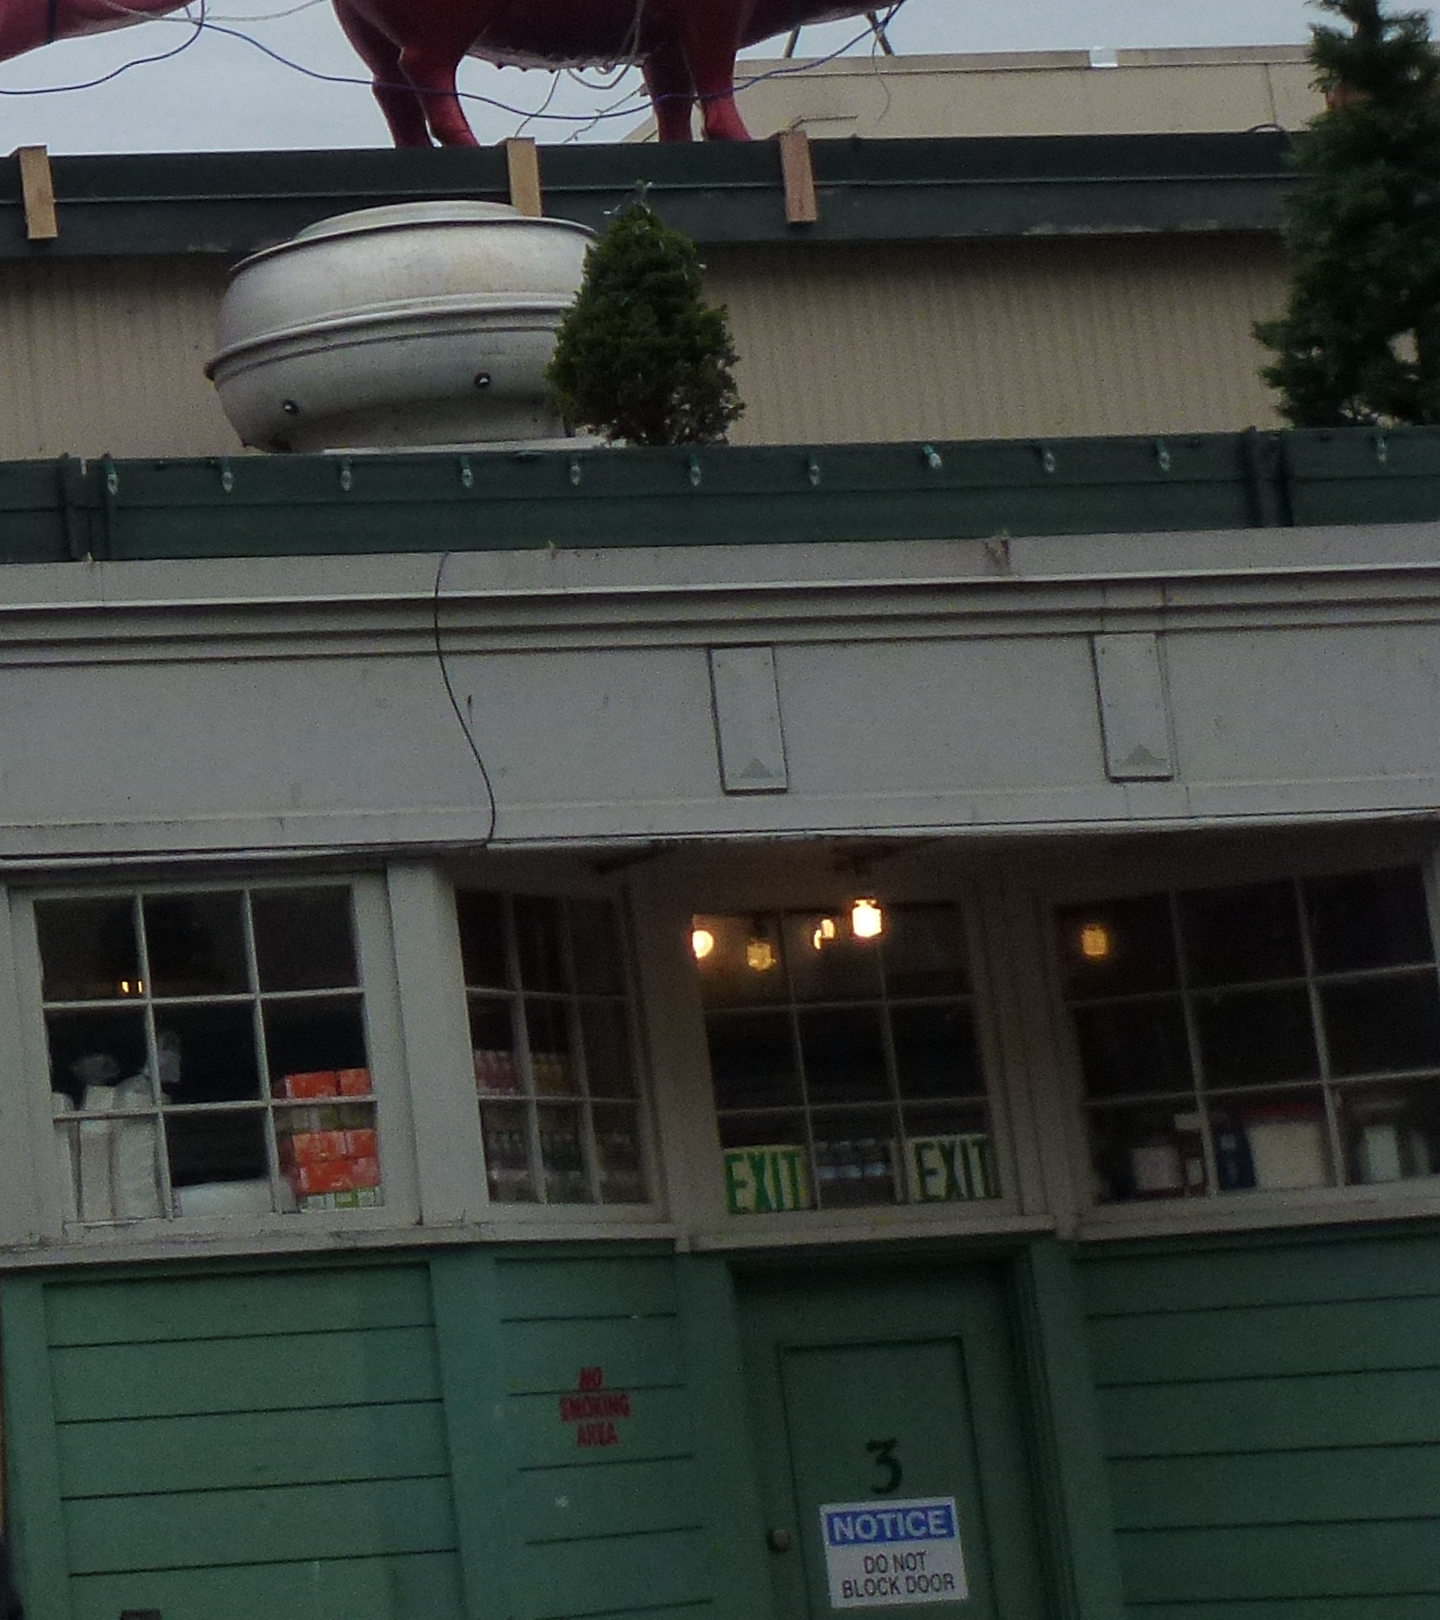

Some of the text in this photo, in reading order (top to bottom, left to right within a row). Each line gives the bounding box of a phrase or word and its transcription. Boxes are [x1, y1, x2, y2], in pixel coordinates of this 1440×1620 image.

[724, 1151, 803, 1213] EXIT
[917, 1138, 994, 1201] EXIT
[866, 1437, 903, 1494] 3
[832, 1510, 948, 1541] NOTICE
[863, 1550, 927, 1574] DO NOT
[842, 1573, 955, 1599] BLOCK DOOR
